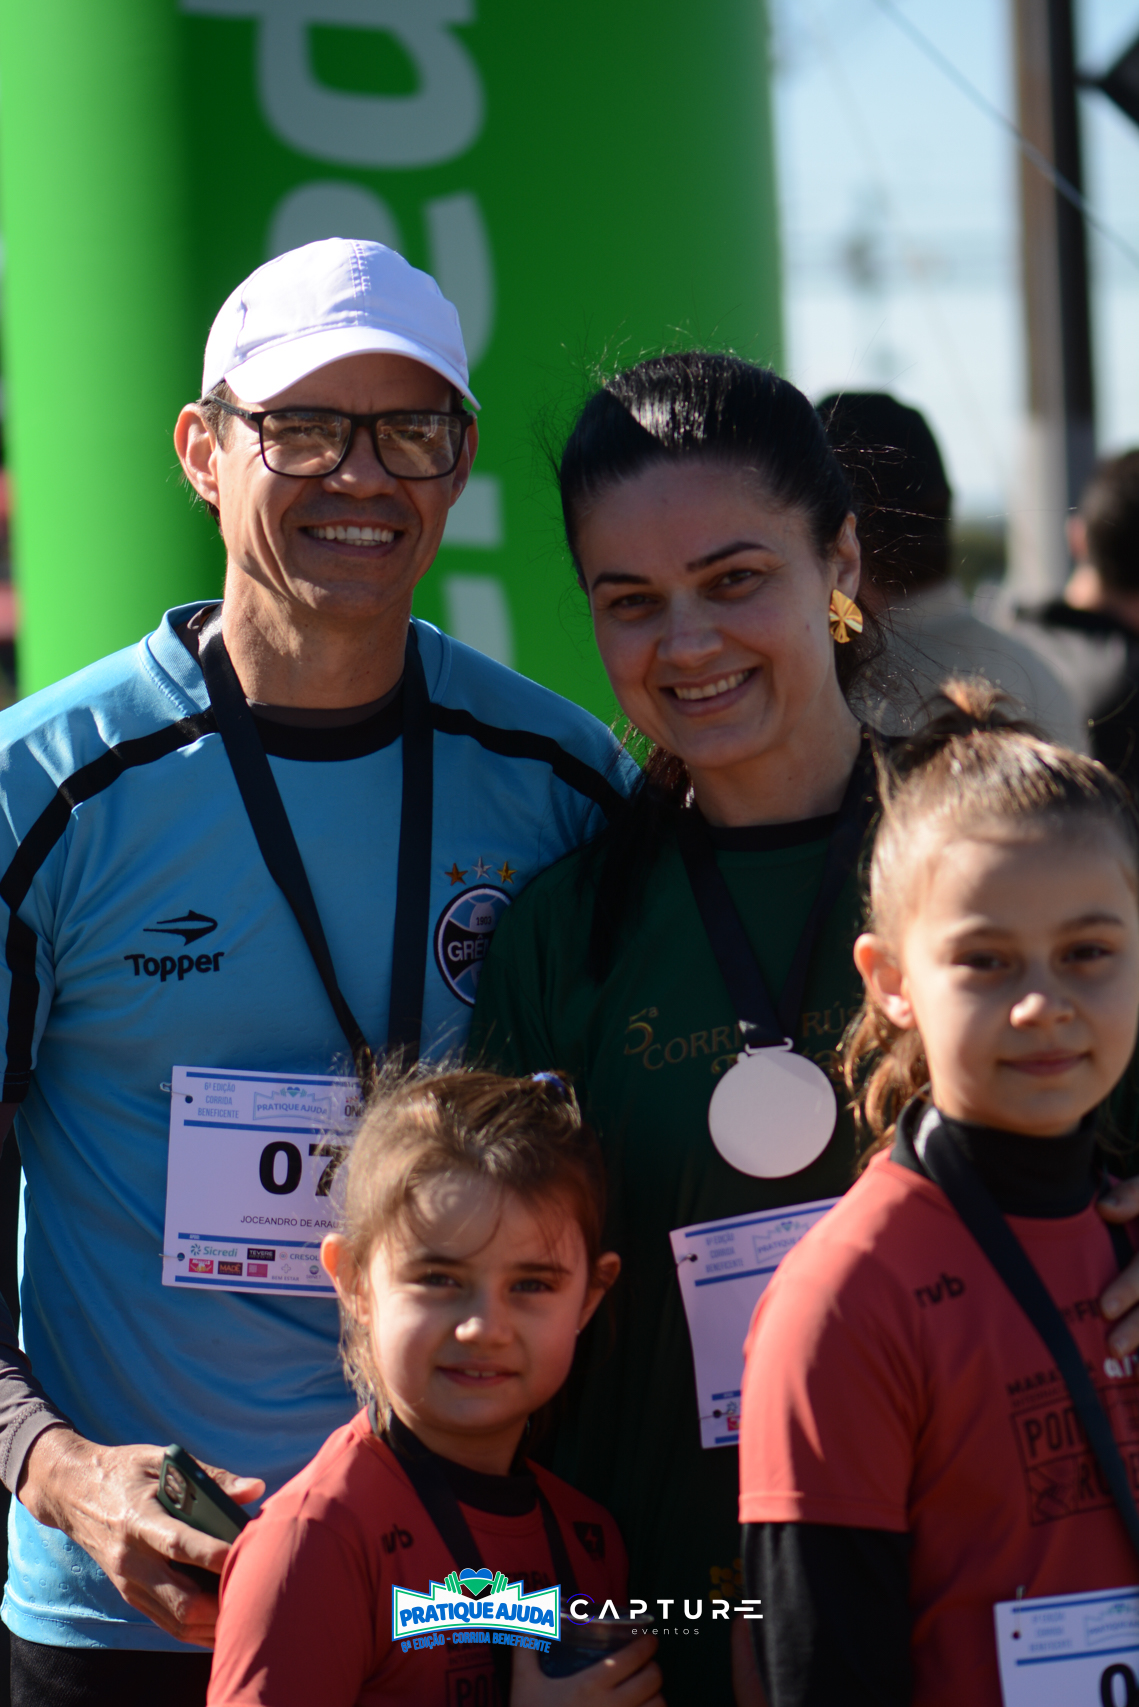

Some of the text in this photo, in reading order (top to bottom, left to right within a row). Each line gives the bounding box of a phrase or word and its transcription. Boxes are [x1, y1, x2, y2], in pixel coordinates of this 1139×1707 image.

[476, 916, 492, 926] 1903
[124, 951, 225, 982] Topper
[212, 1082, 236, 1093] EDIÇÃO
[205, 1095, 233, 1105] CORRIDA
[197, 1107, 240, 1119] BENEFICENTE
[256, 1103, 328, 1115] PRATIQUE AJUDA
[240, 1215, 341, 1229] JOCEANDRO DE ARAU
[203, 1245, 238, 1257] Sicredi
[290, 1253, 320, 1261] CRESOL
